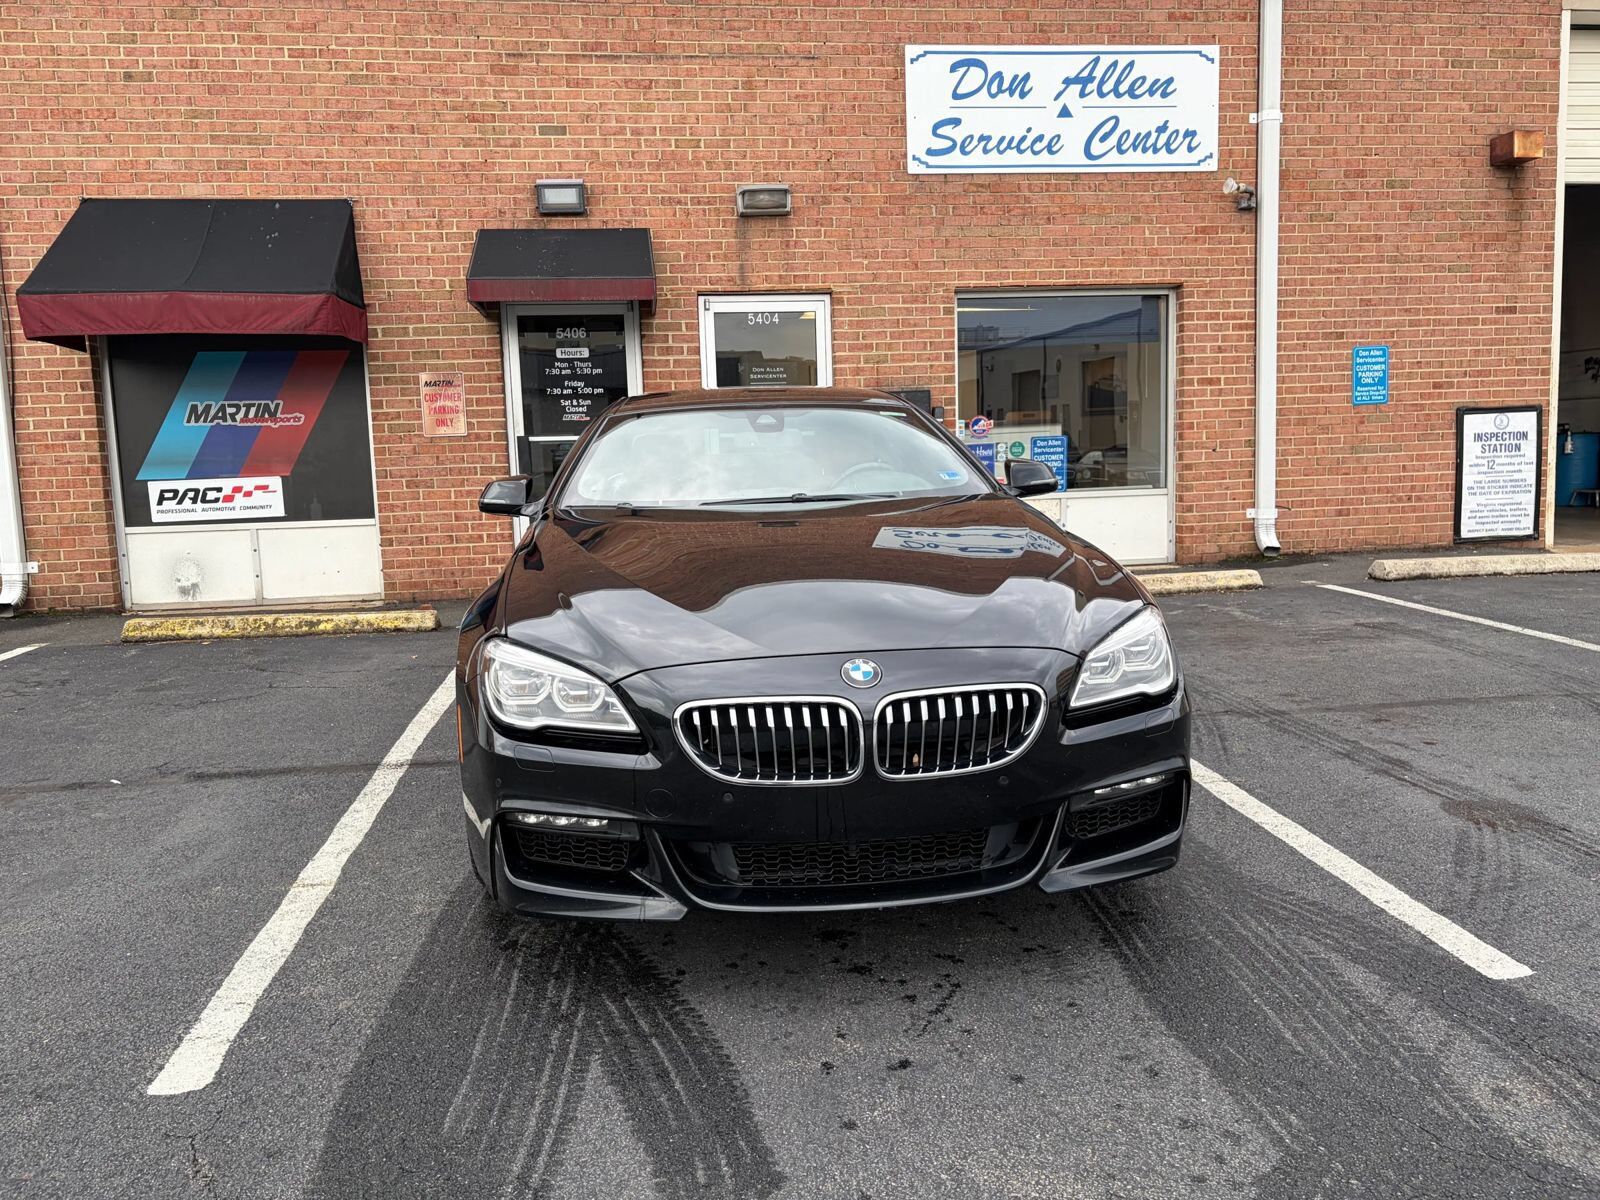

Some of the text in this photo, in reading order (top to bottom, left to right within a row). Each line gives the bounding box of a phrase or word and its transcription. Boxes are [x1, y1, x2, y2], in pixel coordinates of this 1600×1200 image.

[949, 55, 1177, 102] Don Allen
[925, 115, 1201, 161] Service Center
[748, 312, 779, 325] 5404
[556, 328, 586, 338] 5406
[424, 392, 462, 402] CUSTOMER
[186, 402, 281, 424] MARTIN
[428, 405, 459, 415] PARKING
[436, 418, 454, 428] ONLY
[1474, 431, 1528, 442] INSPECTION
[1481, 443, 1521, 454] STATION
[1487, 460, 1495, 470] 12
[156, 487, 223, 506] PAC
